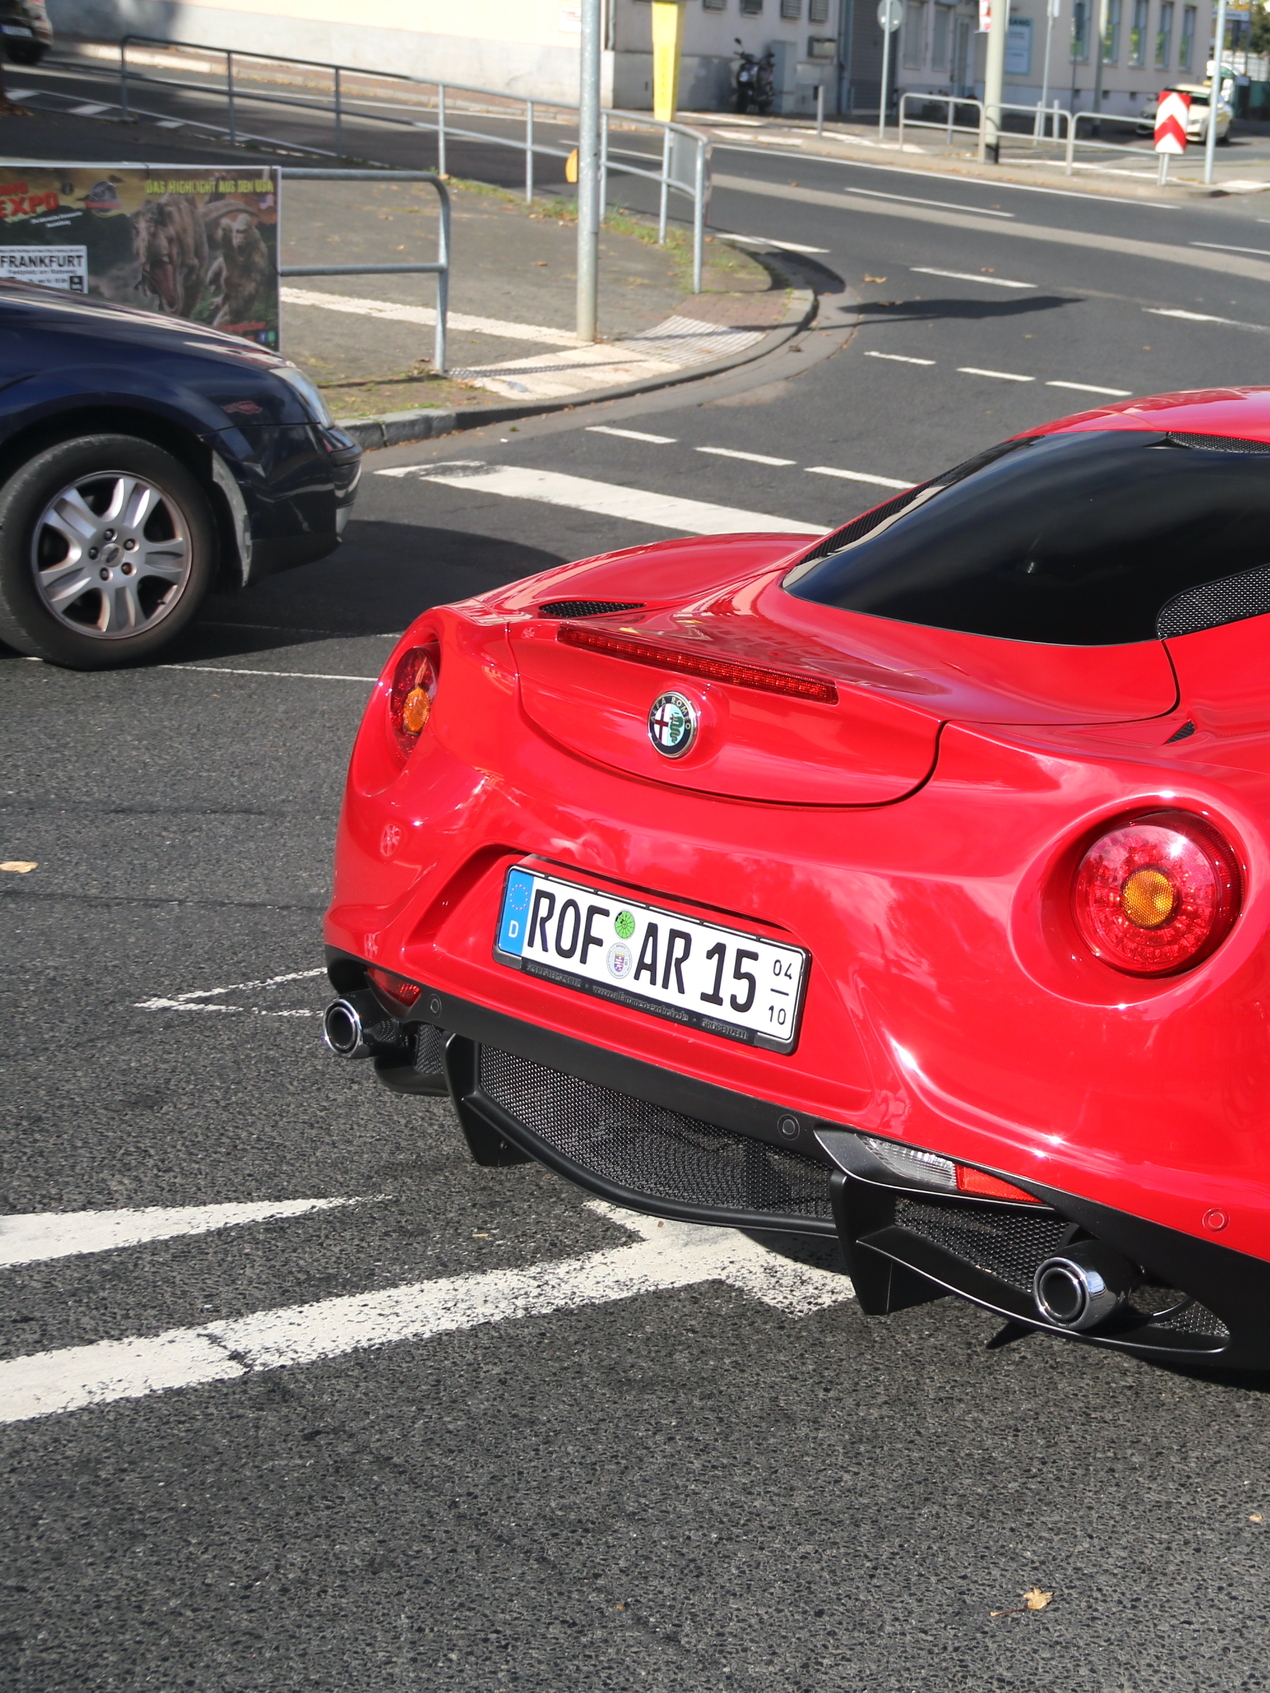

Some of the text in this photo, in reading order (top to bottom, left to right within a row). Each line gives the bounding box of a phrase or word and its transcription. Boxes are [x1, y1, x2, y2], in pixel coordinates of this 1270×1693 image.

[146, 179, 273, 193] DAS HIGHLIGHT AUS DEN USA
[0, 192, 58, 218] EXPO
[0, 255, 84, 268] FRANKFURT
[651, 697, 691, 730] ALFA ROMEO
[508, 920, 519, 938] D
[527, 889, 610, 965] ROF
[634, 922, 692, 995] AR
[700, 942, 759, 1013] 15
[772, 959, 793, 980] 04
[768, 1004, 787, 1026] 10
